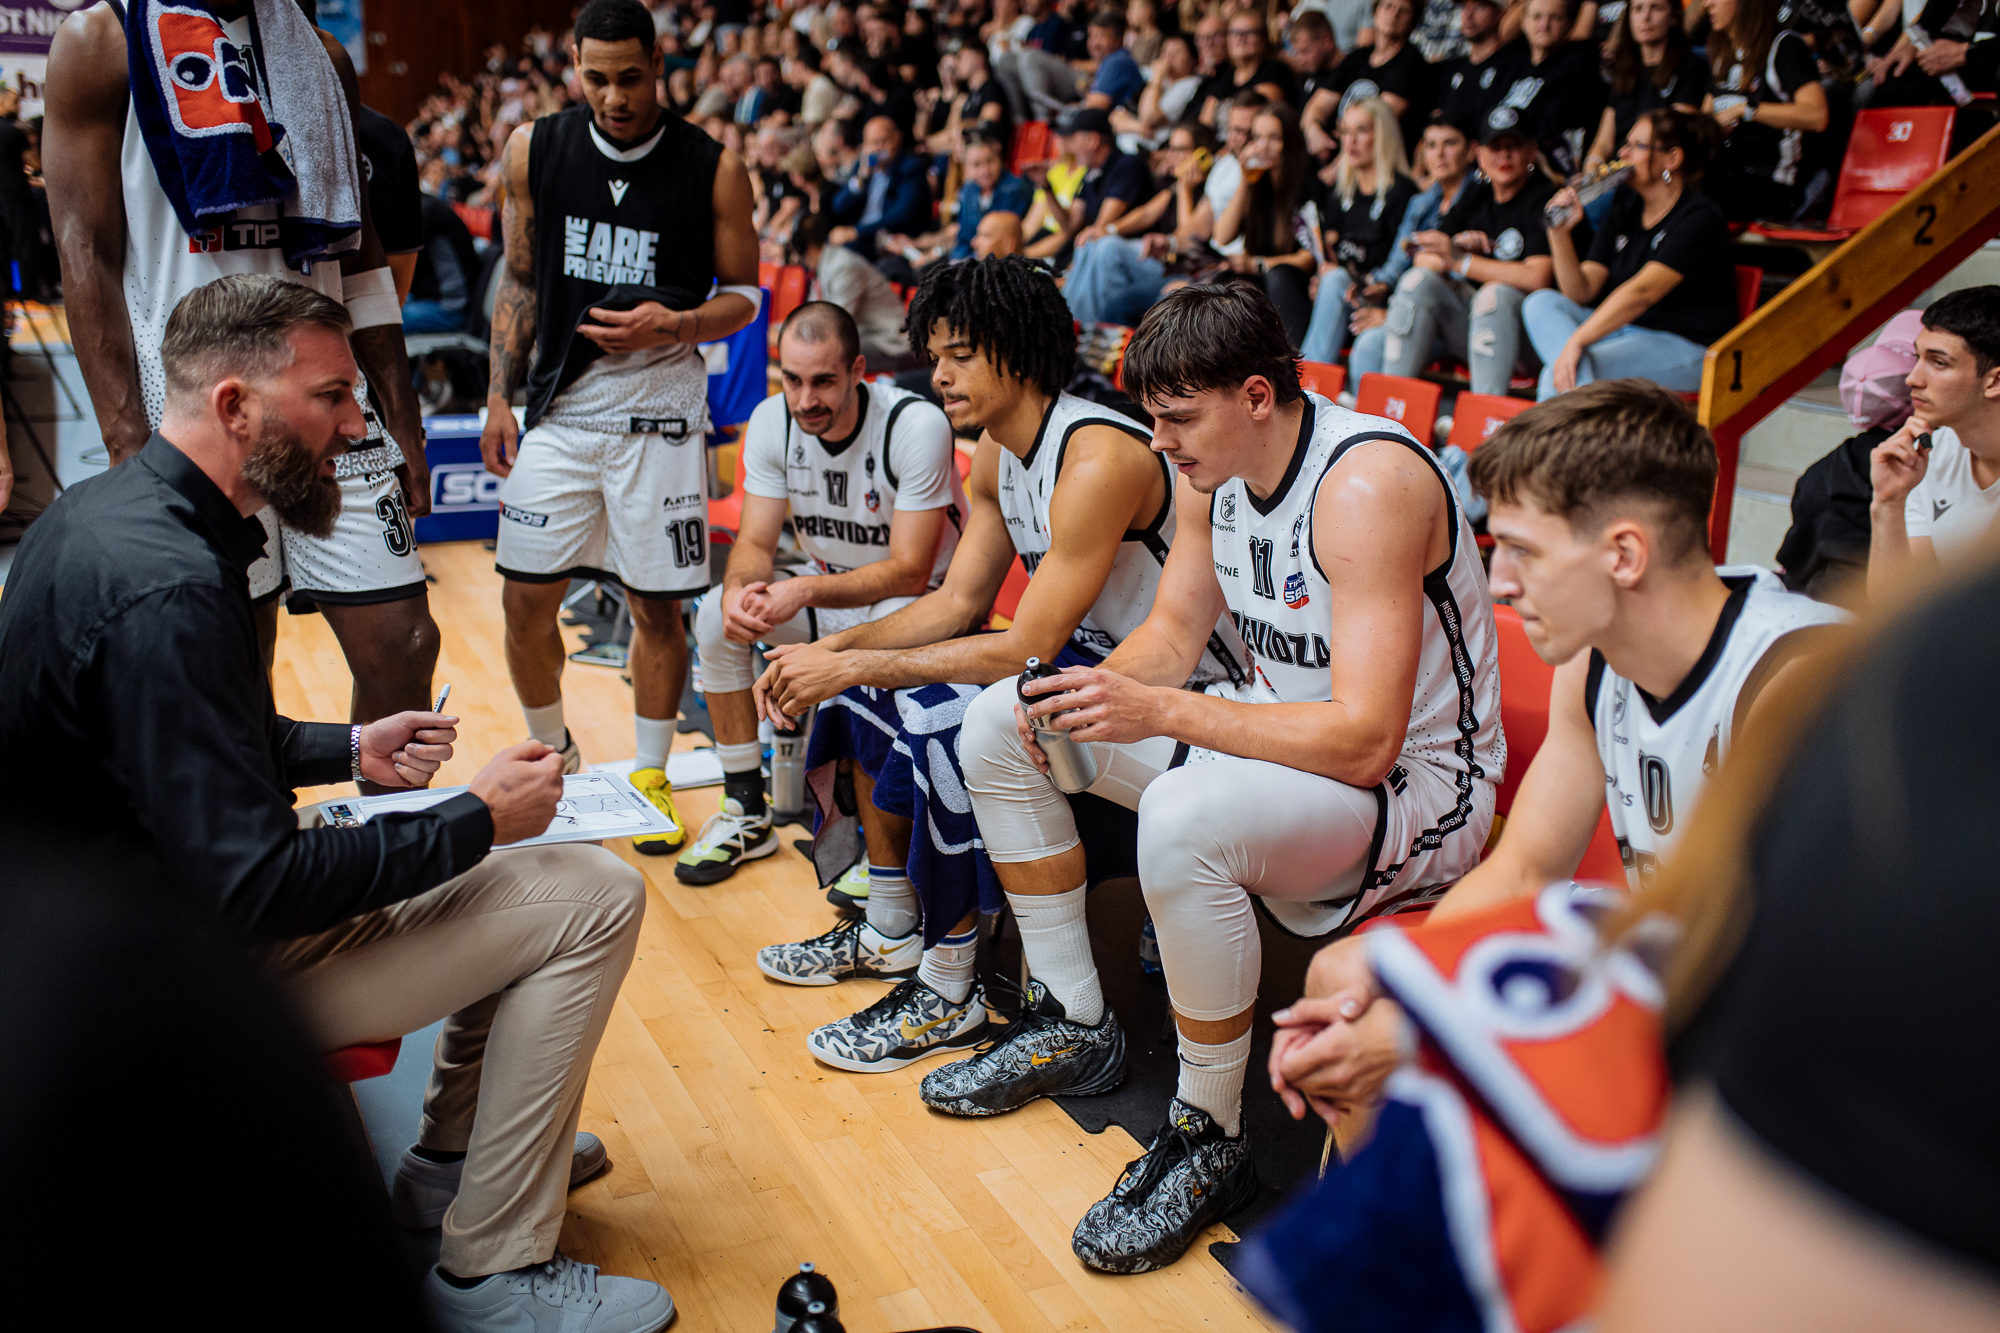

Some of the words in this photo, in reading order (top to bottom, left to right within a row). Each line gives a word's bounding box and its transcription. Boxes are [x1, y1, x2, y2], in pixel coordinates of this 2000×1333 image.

[564, 215, 589, 255] WE
[586, 221, 660, 271] ARE
[1914, 204, 1937, 246] 2
[1730, 350, 1743, 393] 1
[822, 469, 848, 508] 17
[503, 504, 548, 528] TIPOS
[665, 517, 706, 568] 19
[1248, 535, 1276, 600] 11
[780, 743, 795, 757] 17
